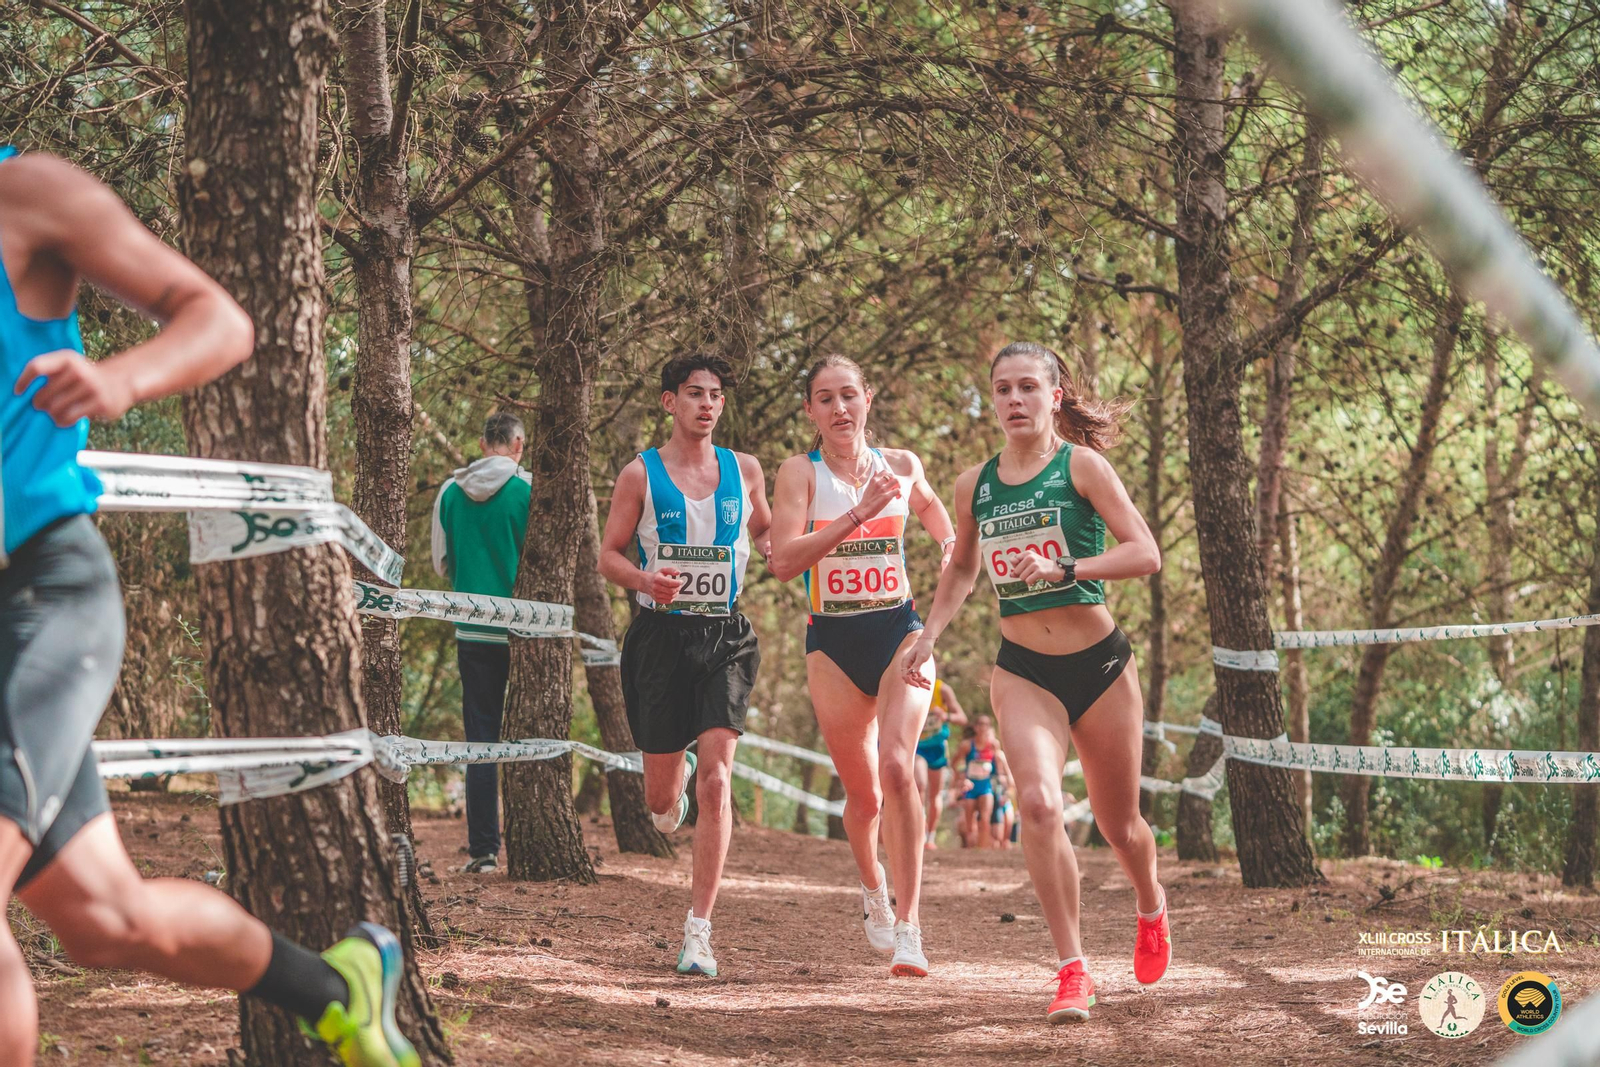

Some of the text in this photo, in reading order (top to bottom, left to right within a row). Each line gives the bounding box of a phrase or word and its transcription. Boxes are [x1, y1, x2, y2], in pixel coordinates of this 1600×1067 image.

[661, 508, 681, 519] vive
[992, 498, 1036, 517] Facsa
[999, 515, 1037, 531] ITÁLICA
[678, 546, 714, 557] ITÁLICA
[842, 541, 881, 553] ITÁLICA
[671, 572, 726, 596] 260
[827, 567, 899, 595] 6306
